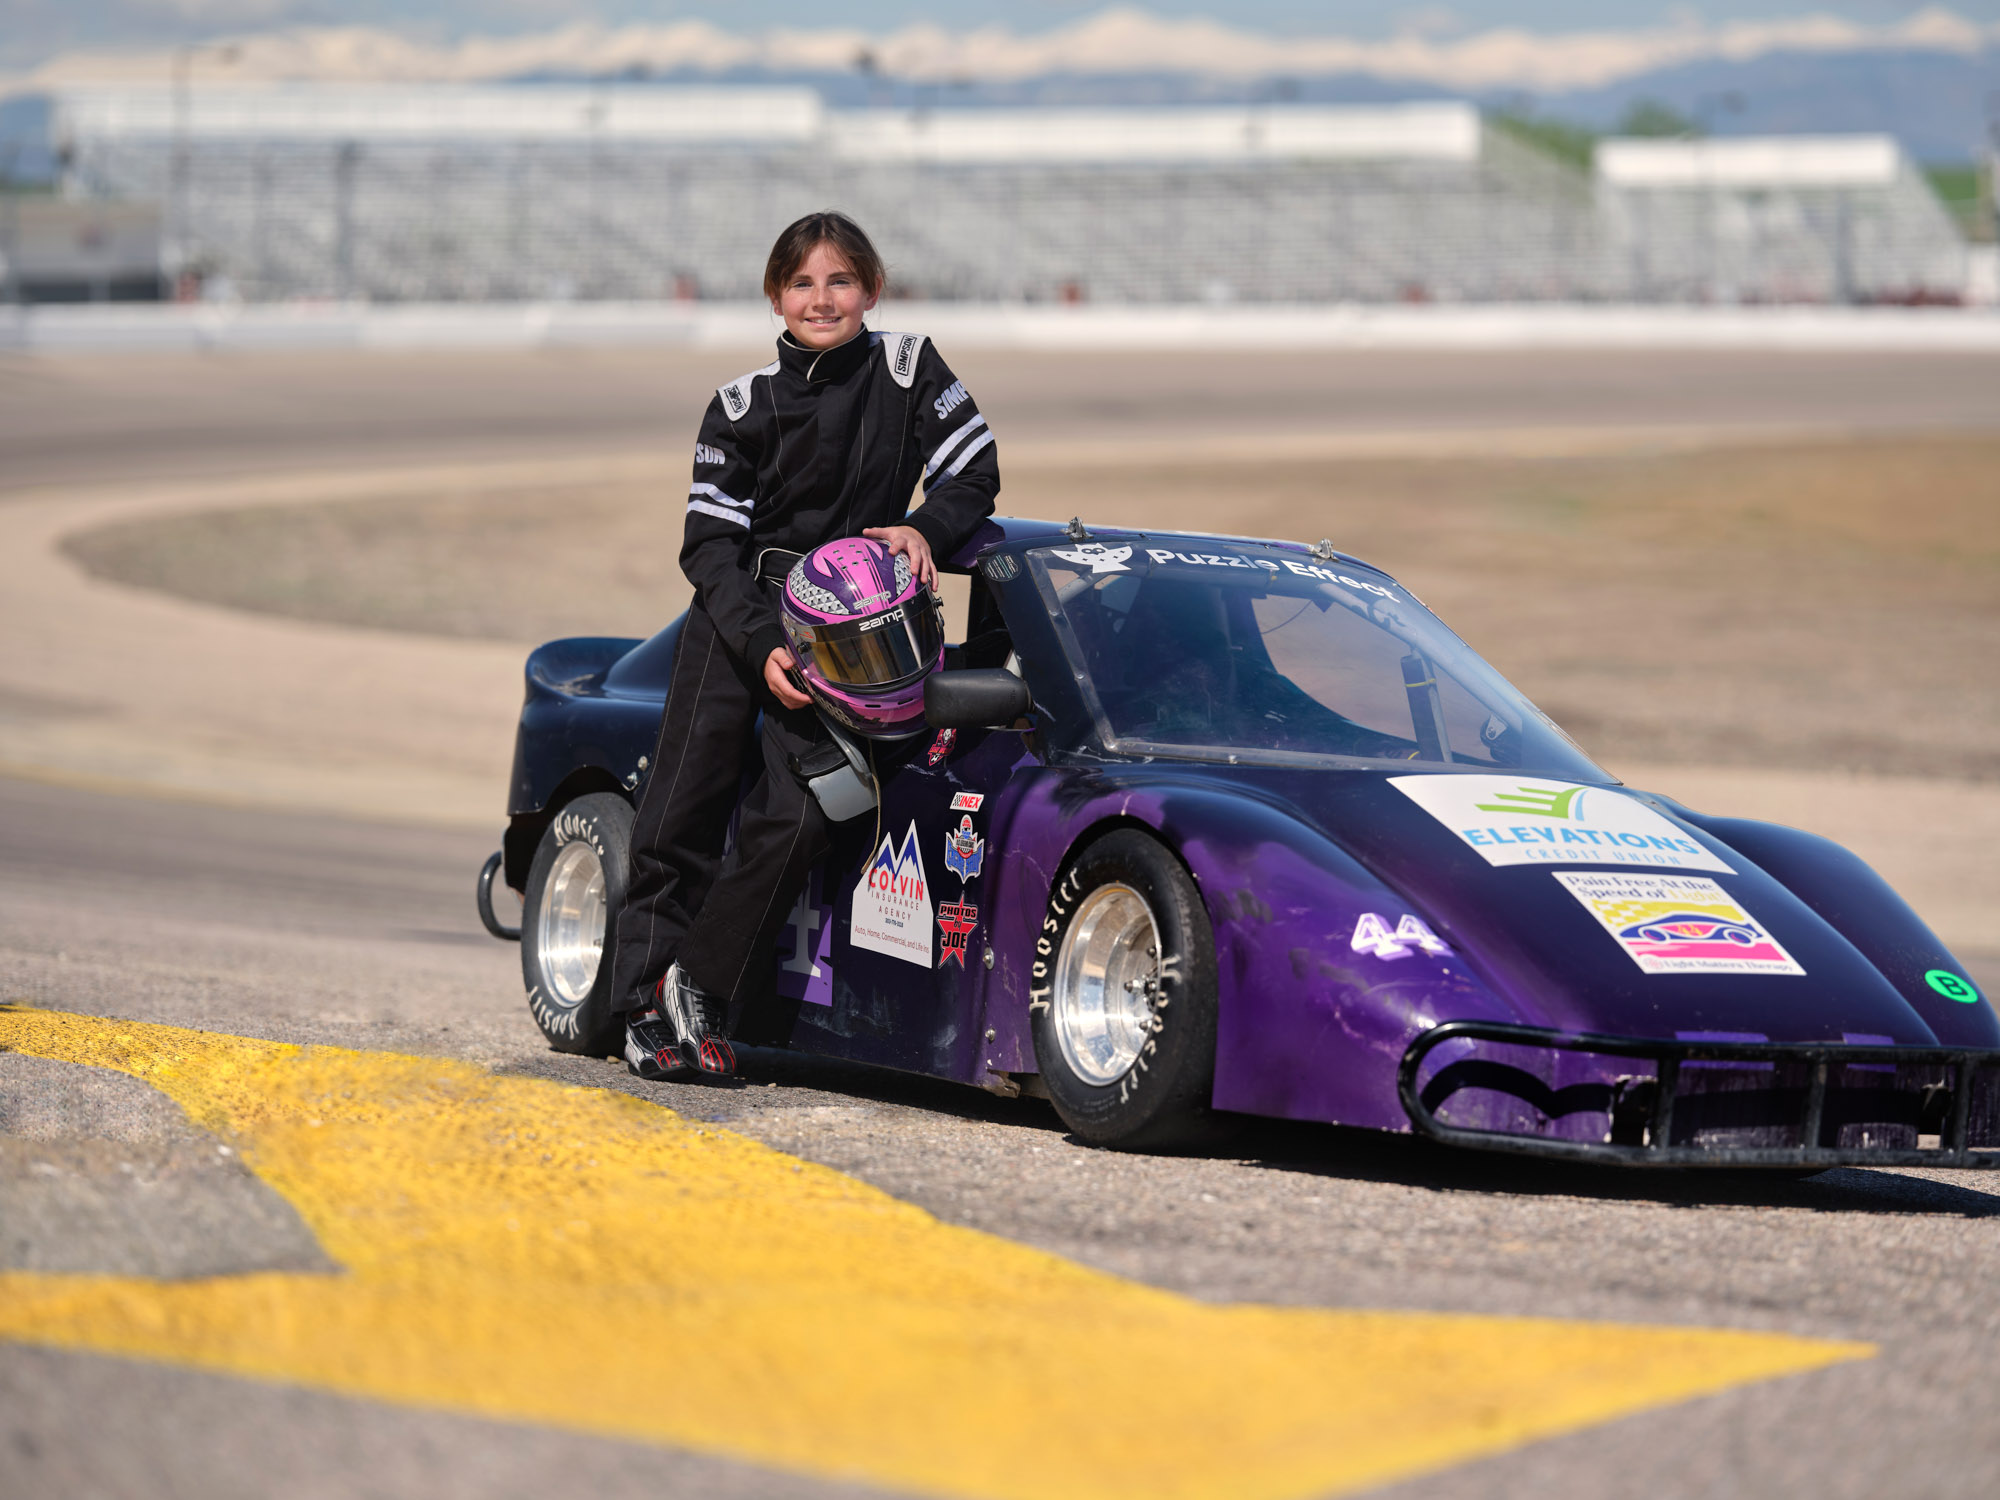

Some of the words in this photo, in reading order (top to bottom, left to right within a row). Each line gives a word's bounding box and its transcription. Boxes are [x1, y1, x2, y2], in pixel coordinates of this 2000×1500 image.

[897, 336, 915, 372] SIMPSON
[1145, 549, 1280, 571] Puzzle
[1280, 559, 1401, 603] Effect
[853, 590, 892, 610] zamp
[858, 608, 905, 632] zamp
[959, 795, 982, 809] INEX
[1462, 826, 1700, 855] ELEVATIONS
[1525, 849, 1598, 860] CREDIT
[1613, 851, 1682, 865] UNION
[868, 867, 924, 902] COLVIN
[1565, 875, 1612, 888] Pain
[1613, 876, 1658, 889] Free
[1659, 878, 1680, 891] At
[1681, 880, 1716, 891] the
[1577, 886, 1644, 900] Speed
[1646, 888, 1669, 899] of
[871, 890, 919, 911] INSURANCE
[878, 905, 912, 921] AGENCY
[940, 905, 977, 918] PHOTOS
[953, 917, 963, 931] by
[942, 931, 967, 949] JOE
[1350, 912, 1455, 961] 44
[1934, 975, 1969, 996] B
